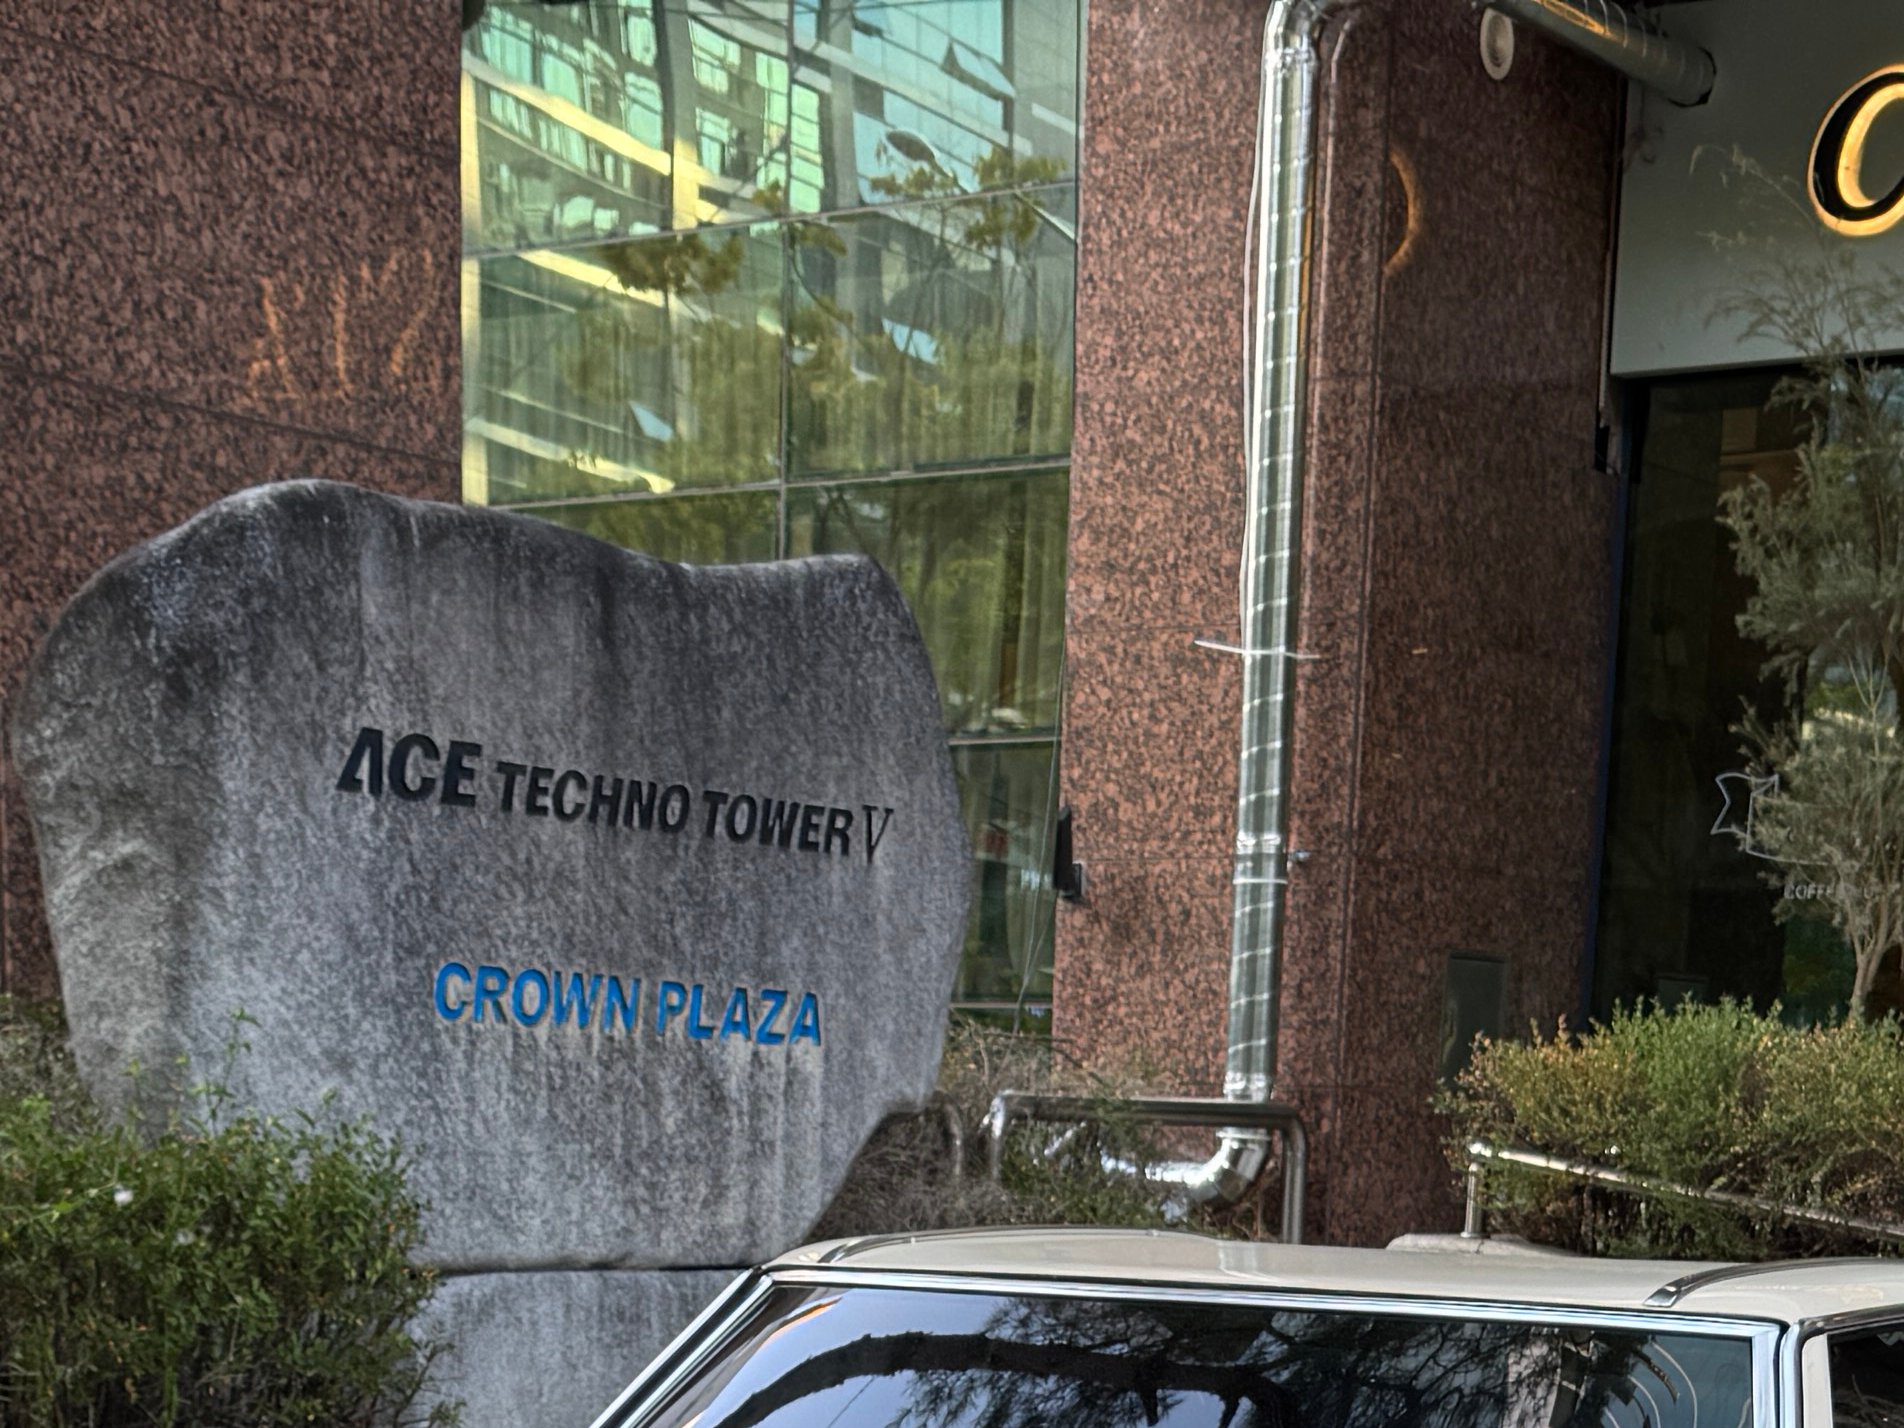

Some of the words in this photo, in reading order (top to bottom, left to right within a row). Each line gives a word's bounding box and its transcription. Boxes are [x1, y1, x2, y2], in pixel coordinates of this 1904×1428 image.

[337, 727, 483, 808] ACE
[496, 760, 690, 836] TECHNO
[702, 790, 855, 857] TOWER
[434, 961, 642, 1034] CROWN
[656, 980, 822, 1047] PLAZA
